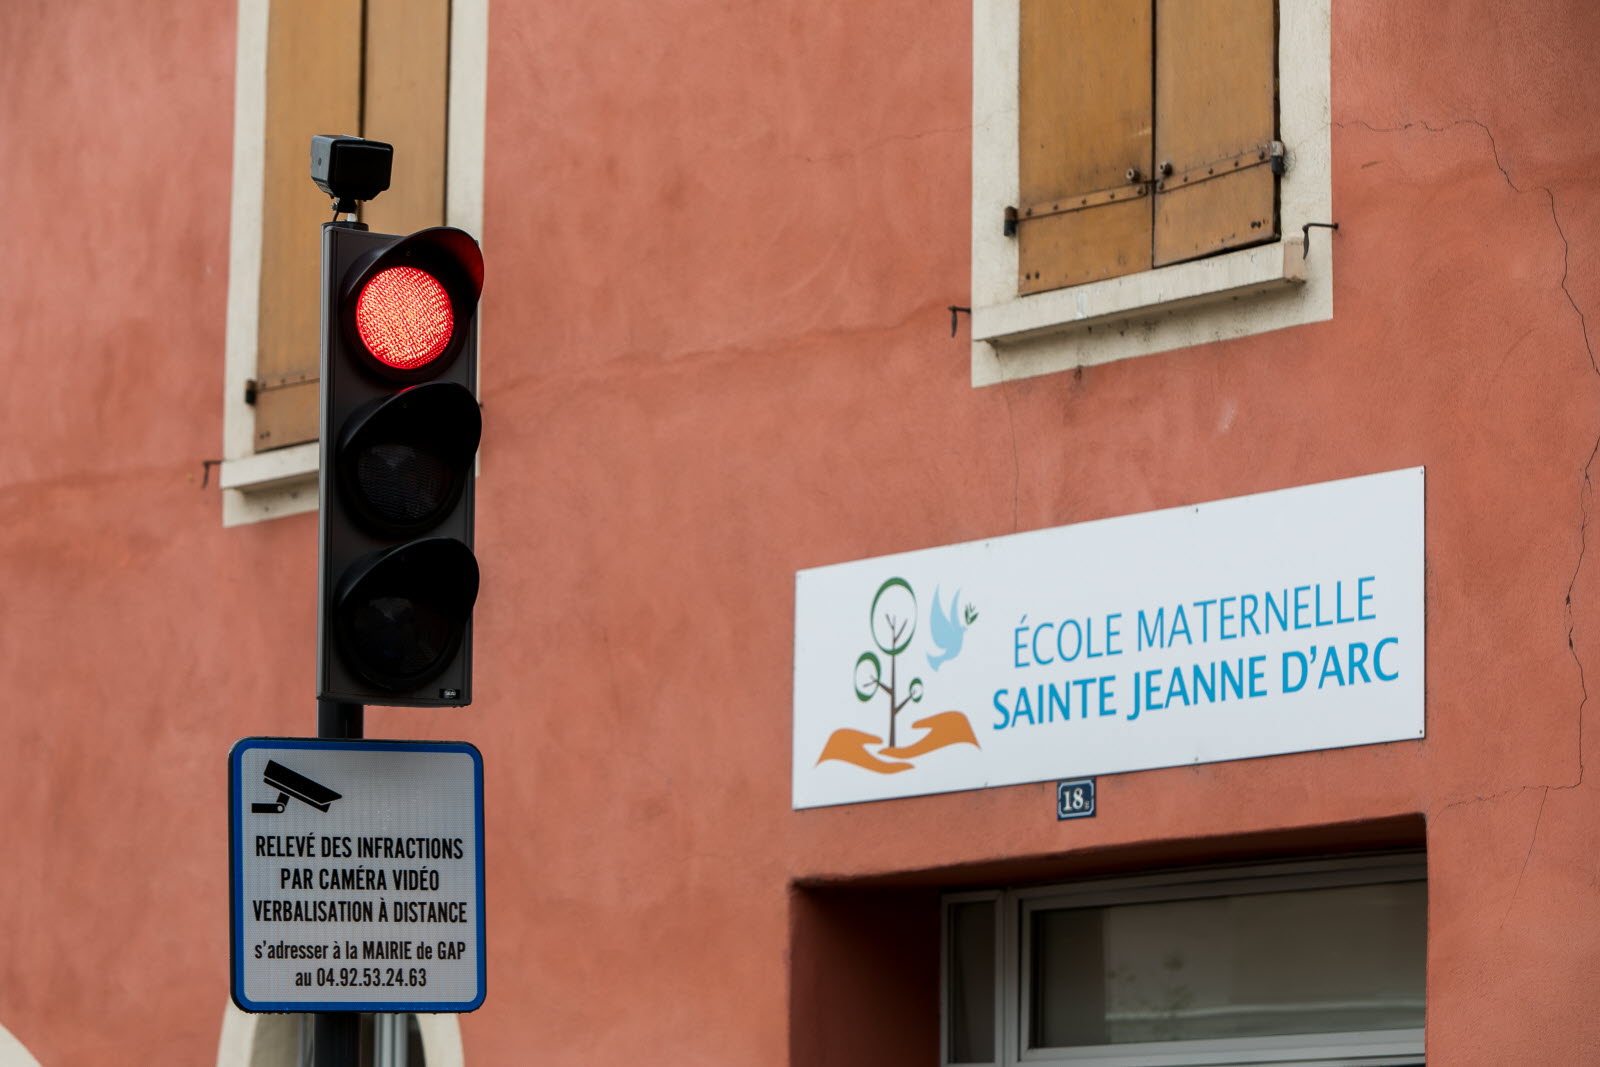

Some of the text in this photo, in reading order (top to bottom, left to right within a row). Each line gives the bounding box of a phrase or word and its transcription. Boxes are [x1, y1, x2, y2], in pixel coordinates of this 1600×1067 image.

[1014, 576, 1376, 668] ÉCOLE MATERNELLE
[993, 637, 1399, 730] SAINTE JEANNE D'ARC
[256, 833, 463, 859] RELEVÉ DES INFRACTIONS
[280, 865, 439, 891] PAR CAMÉRA VIDÉO
[253, 898, 467, 923] VERBALISATION À DISTANCE
[255, 941, 465, 959] s'adresser à la MAIRIE de GAP
[296, 968, 426, 986] au 04.92.53.24.63
